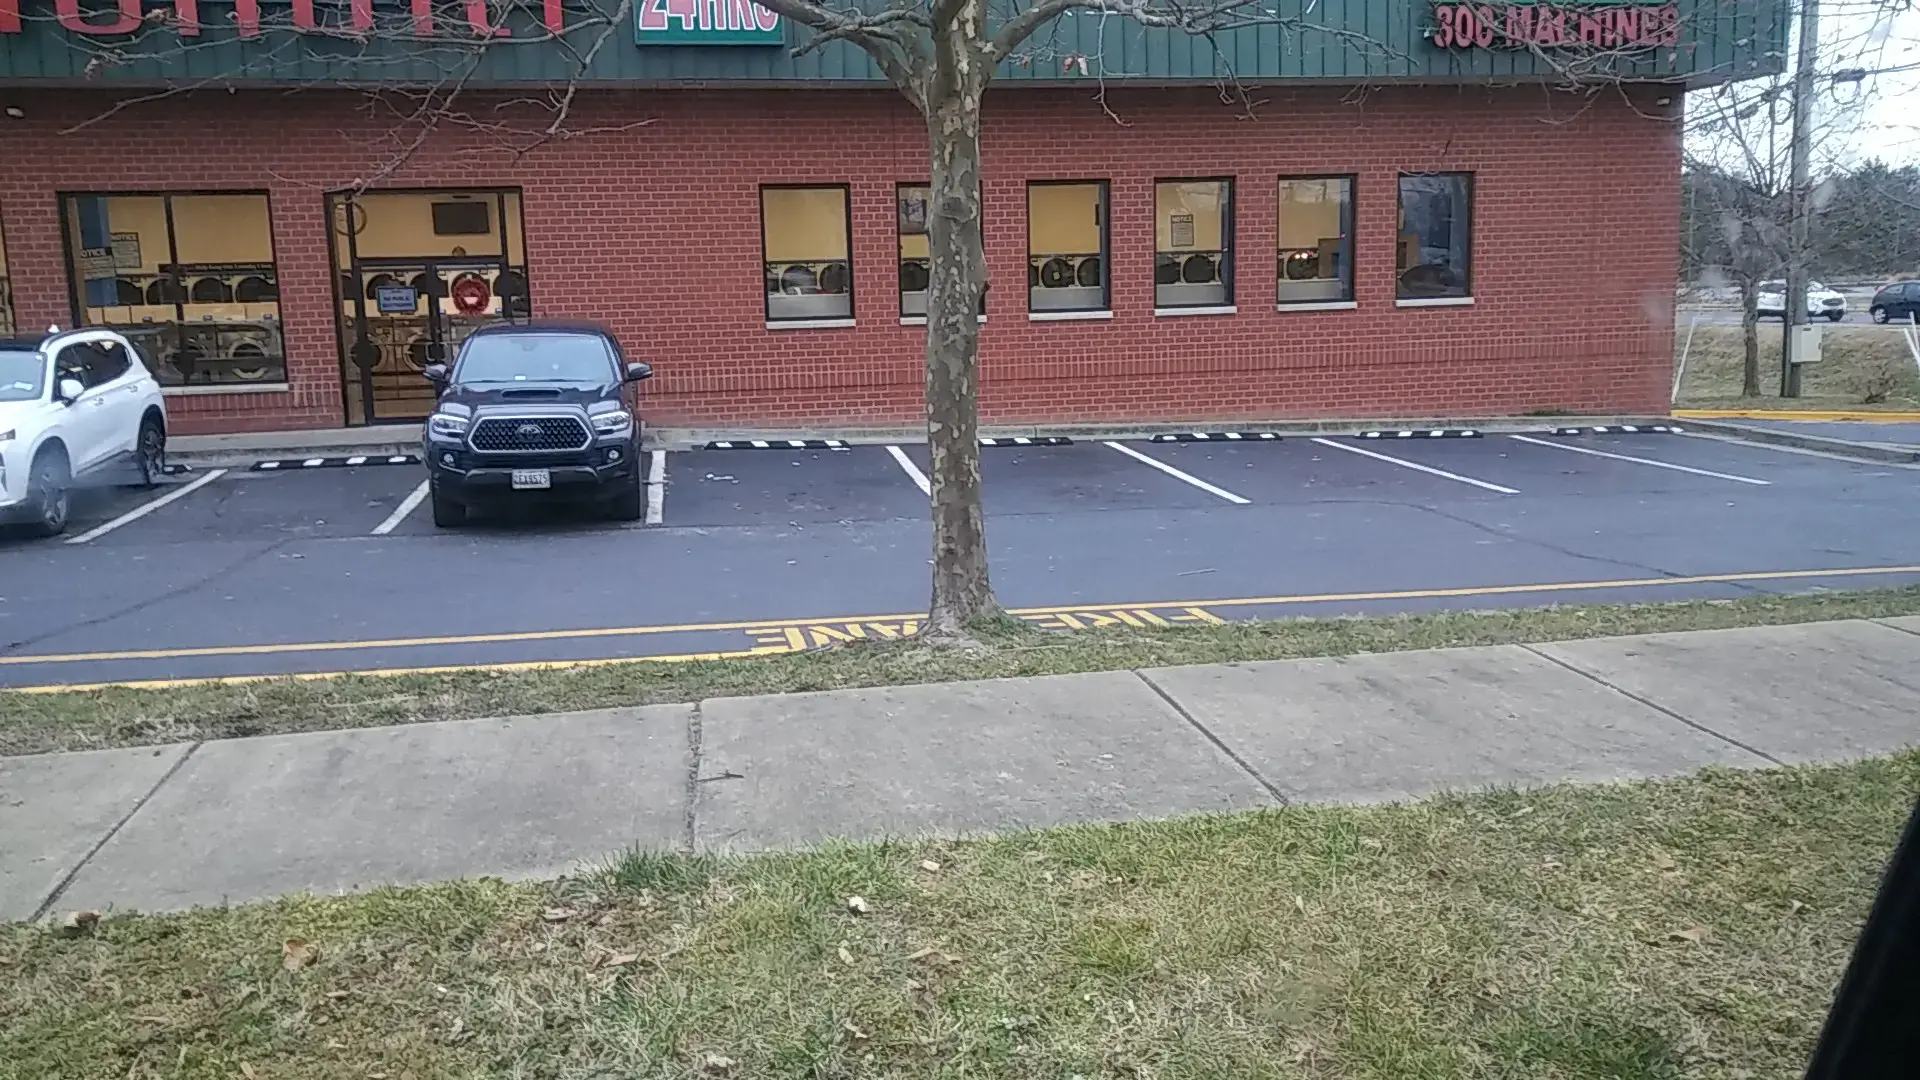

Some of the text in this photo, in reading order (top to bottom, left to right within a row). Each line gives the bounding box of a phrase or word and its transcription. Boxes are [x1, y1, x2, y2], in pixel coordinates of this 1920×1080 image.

[1505, 6, 1680, 46] MAHINES
[80, 248, 106, 257] OTICE
[744, 620, 919, 651] ANE
